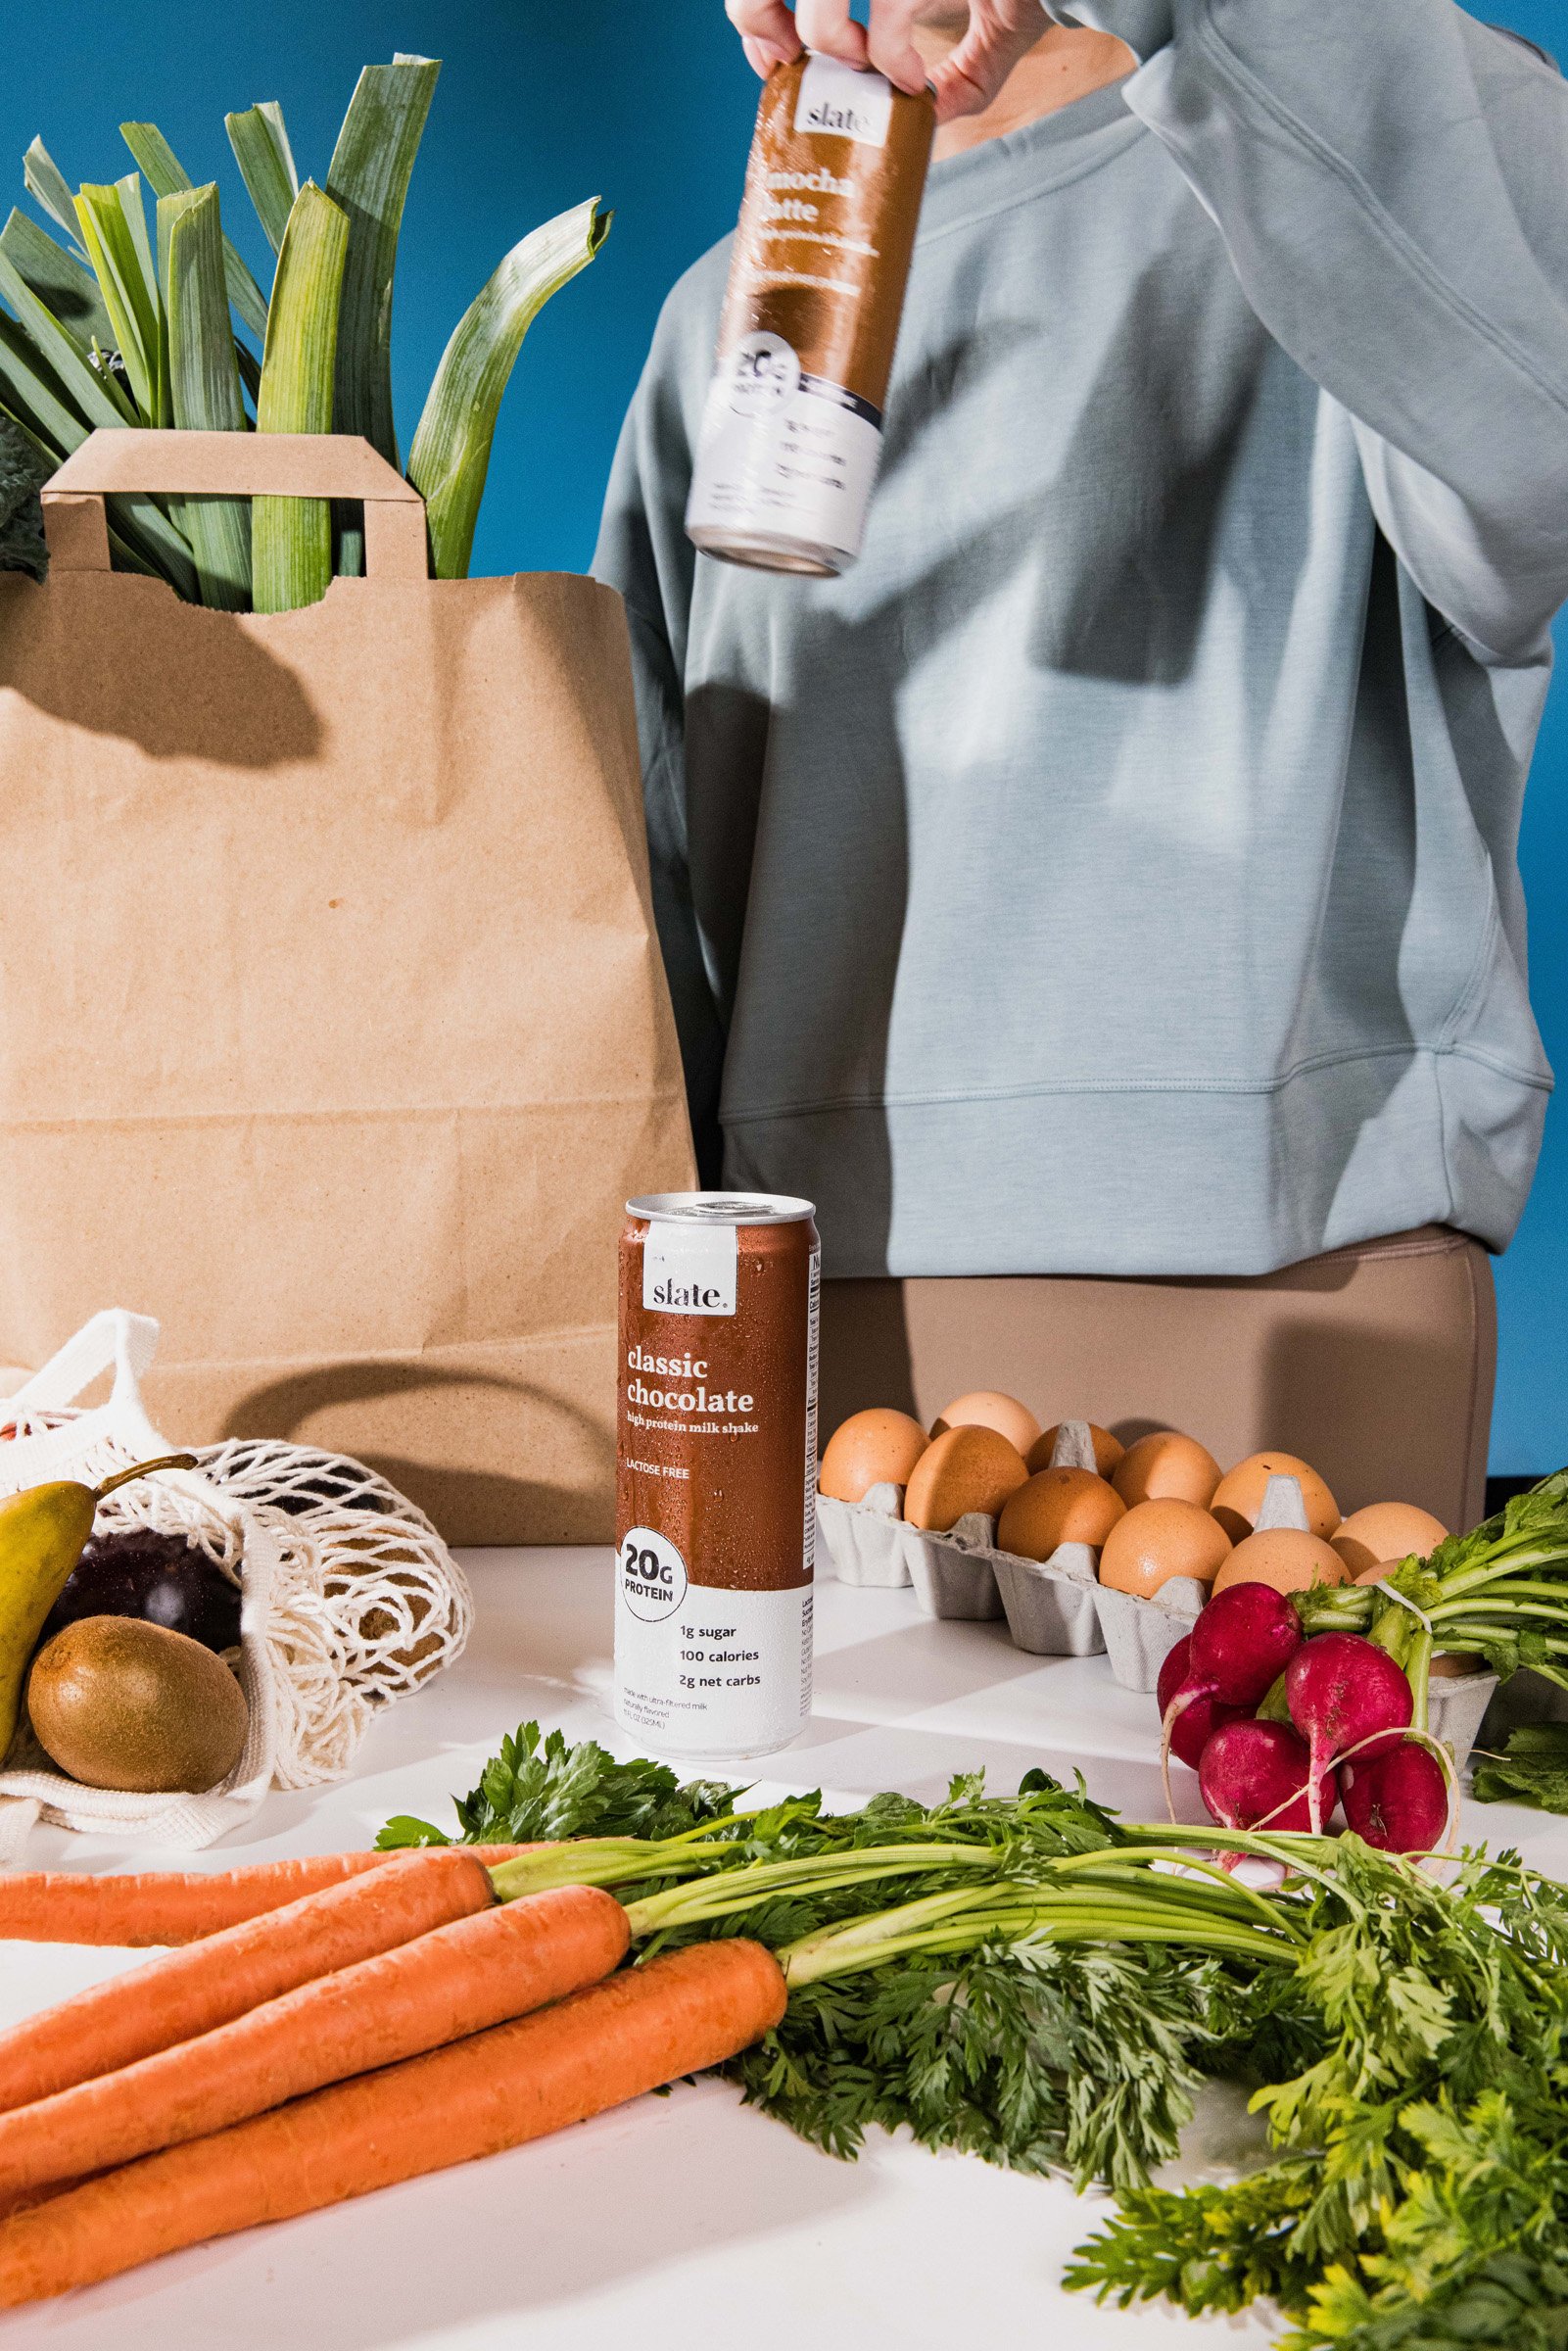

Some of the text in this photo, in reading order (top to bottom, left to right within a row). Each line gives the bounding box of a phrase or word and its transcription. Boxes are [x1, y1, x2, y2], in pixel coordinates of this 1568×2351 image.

[628, 1345, 708, 1378] classic
[627, 1378, 754, 1413] chocolate
[627, 1411, 759, 1435] high protein milk shake
[626, 1457, 690, 1480] LACTOSE FREE
[625, 1543, 673, 1585] 20G
[625, 1578, 674, 1603] PROTEIN
[680, 1625, 736, 1641] 1g sugar
[680, 1650, 760, 1663] 100 calories
[679, 1674, 761, 1690] 2g net carbs
